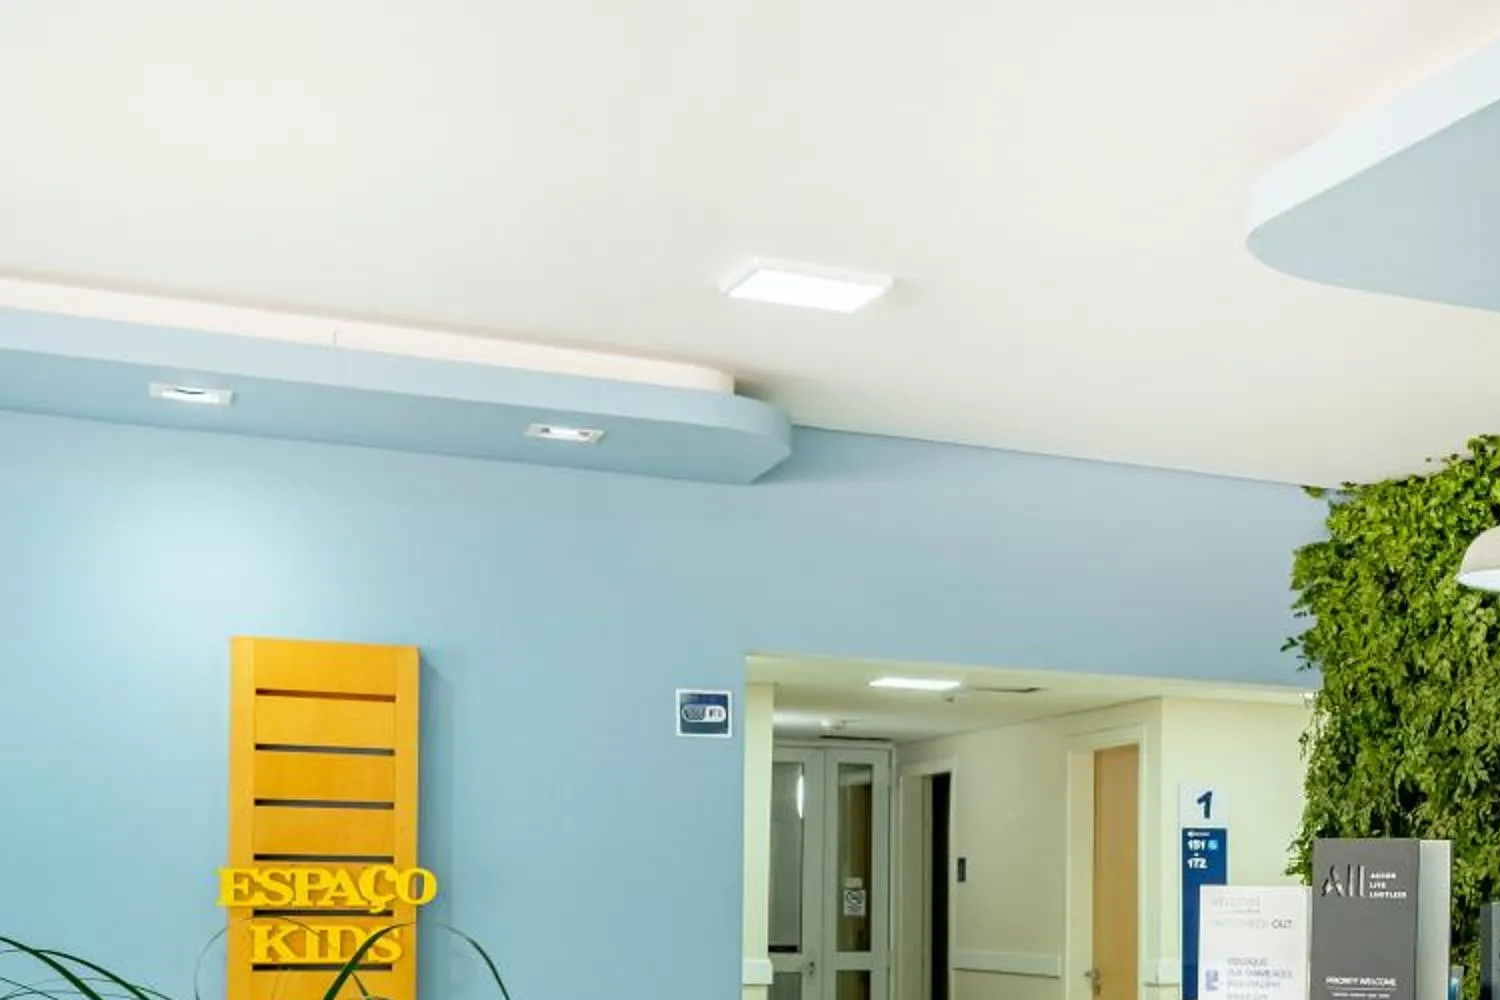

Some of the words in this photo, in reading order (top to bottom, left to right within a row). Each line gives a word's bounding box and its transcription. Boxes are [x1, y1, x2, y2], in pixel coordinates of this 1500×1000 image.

[1197, 790, 1213, 819] 1
[1187, 857, 1208, 869] 172
[215, 864, 438, 914] ESPAÇO
[249, 923, 403, 964] KIDS
